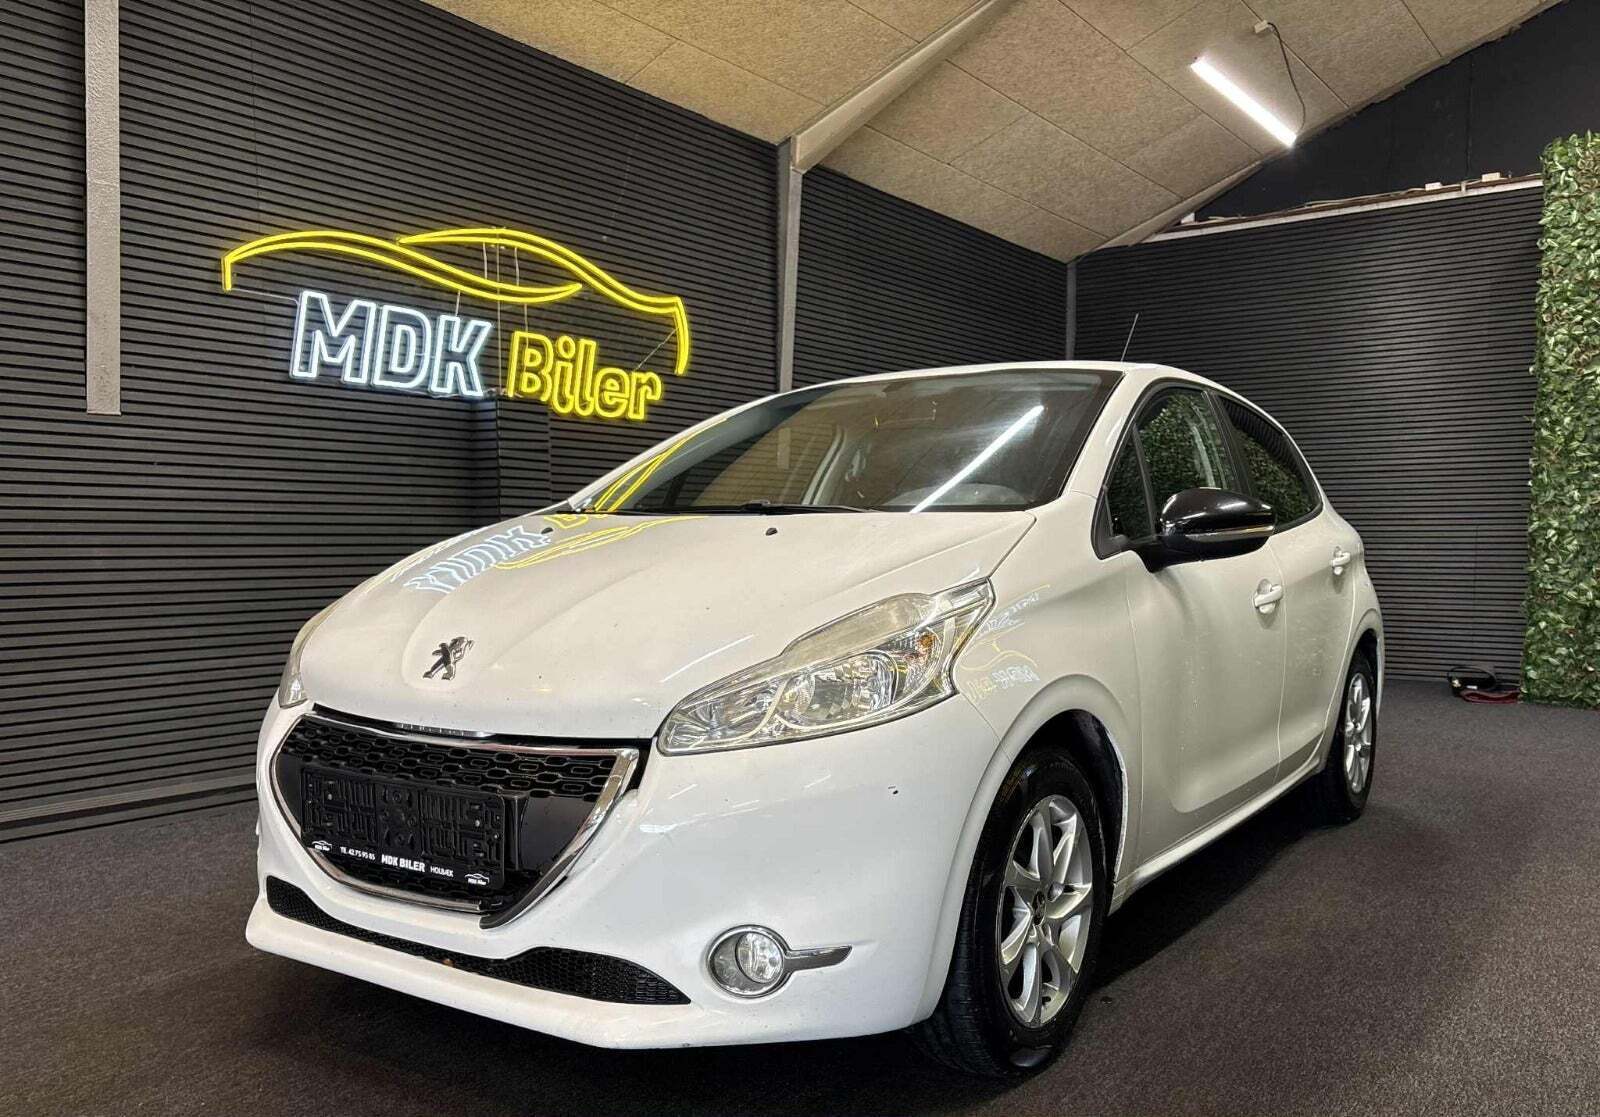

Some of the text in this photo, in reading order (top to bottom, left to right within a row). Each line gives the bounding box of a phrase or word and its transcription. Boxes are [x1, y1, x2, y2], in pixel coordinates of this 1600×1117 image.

[290, 290, 663, 420] MDK Biler
[381, 854, 398, 867] MDK
[399, 858, 425, 872] BILER
